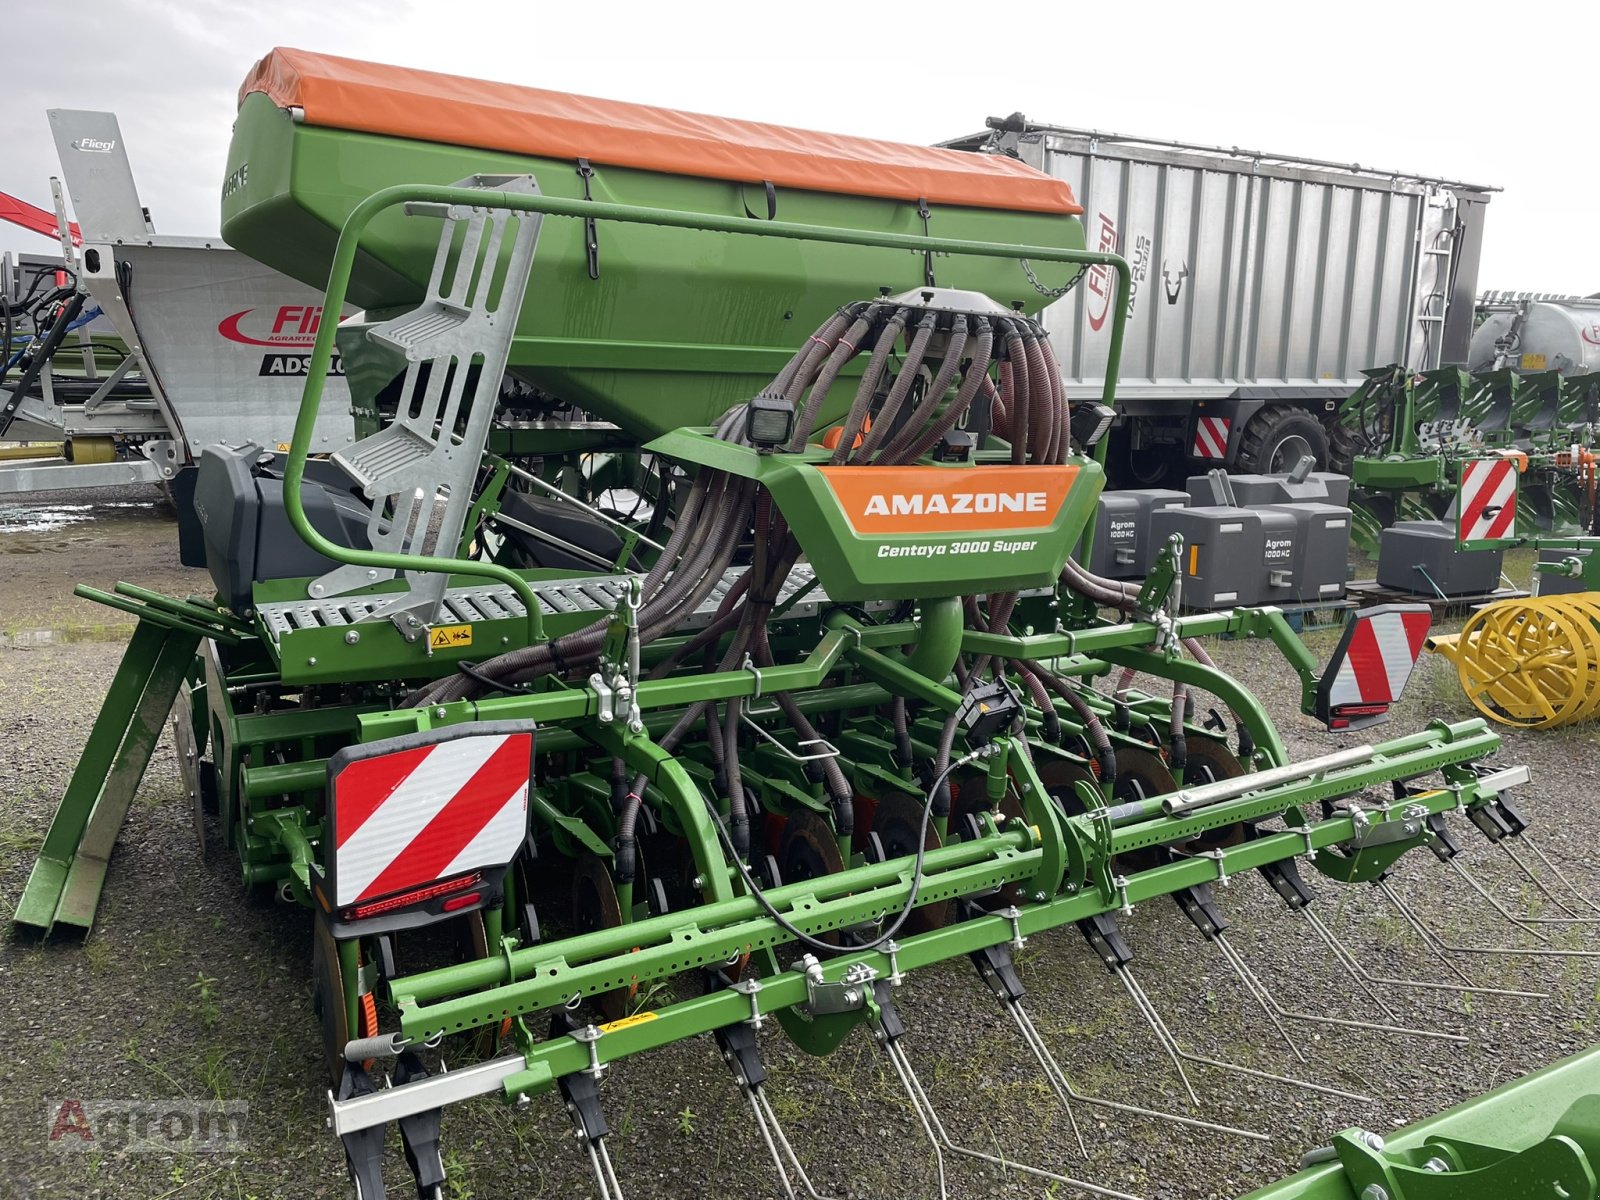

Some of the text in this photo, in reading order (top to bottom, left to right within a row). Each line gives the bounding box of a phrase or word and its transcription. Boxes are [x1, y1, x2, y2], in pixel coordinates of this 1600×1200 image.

[81, 138, 115, 151] Fliegl
[272, 305, 324, 334] Fli
[864, 492, 1047, 516] AMAZONE
[1110, 520, 1135, 530] Agrom
[877, 540, 1038, 558] Centaya 3000 Super
[1265, 539, 1292, 549] Agrom
[1264, 550, 1281, 558] 1000
